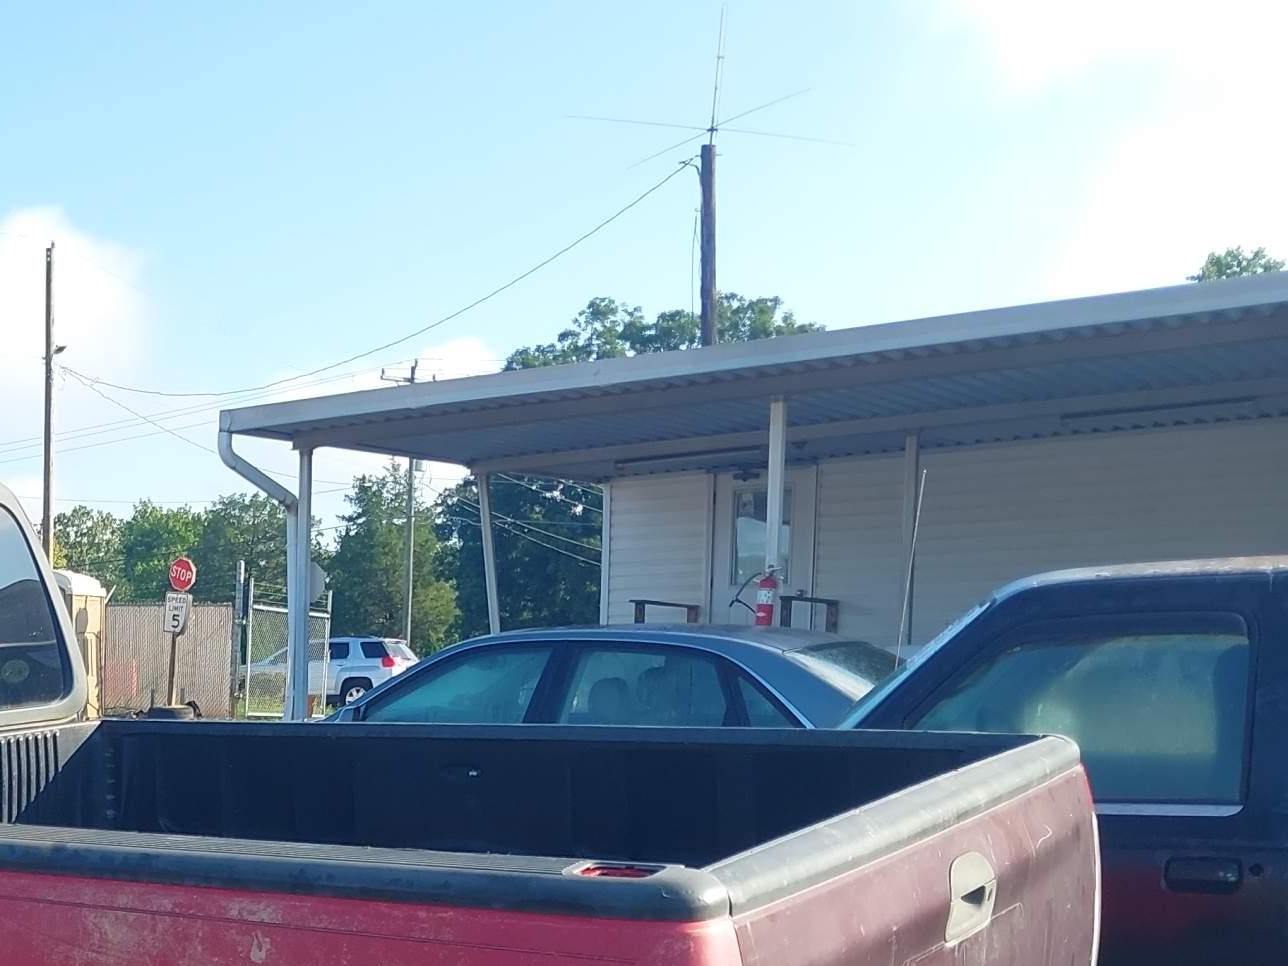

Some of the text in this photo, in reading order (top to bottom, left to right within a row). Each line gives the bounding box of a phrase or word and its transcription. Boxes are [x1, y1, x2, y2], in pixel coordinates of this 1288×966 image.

[171, 565, 192, 581] STOP
[167, 596, 187, 604] SPEED
[171, 614, 180, 628] 5
